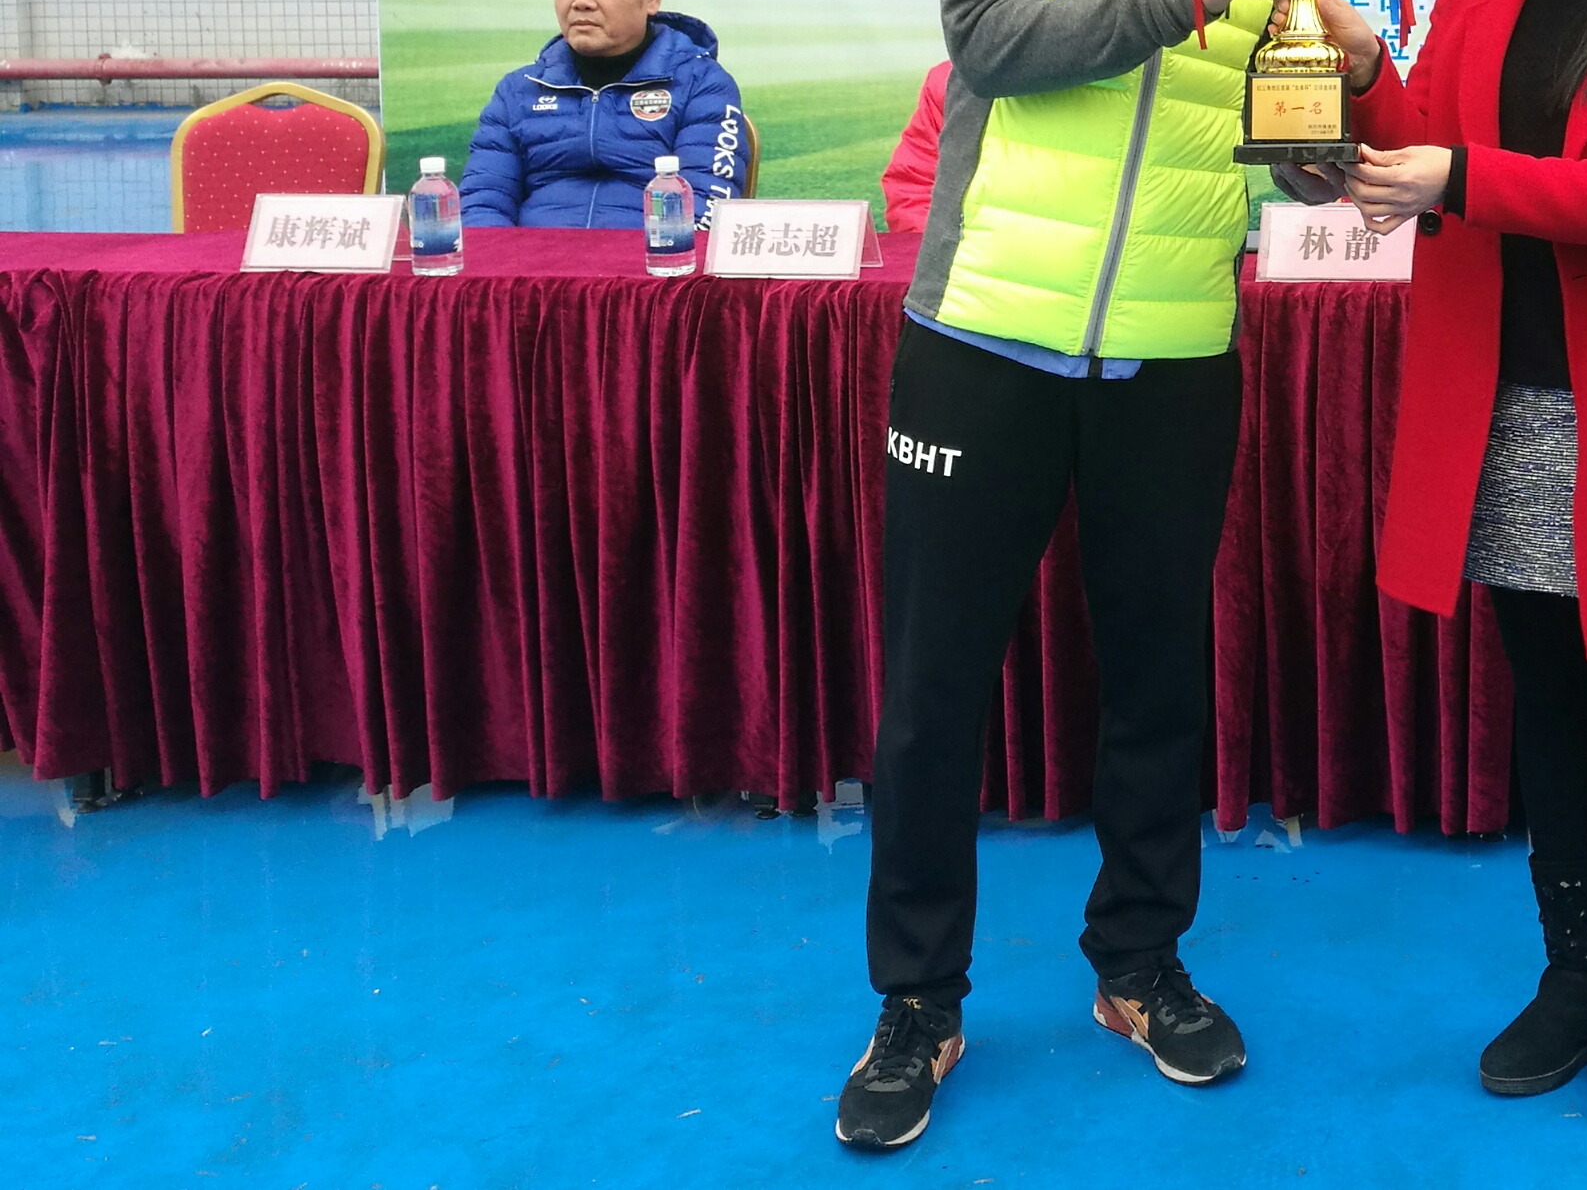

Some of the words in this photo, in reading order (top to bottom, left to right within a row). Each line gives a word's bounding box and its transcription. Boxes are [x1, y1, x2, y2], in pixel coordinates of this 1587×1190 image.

[1274, 101, 1322, 117] 第一名
[713, 104, 741, 179] LOOKS
[264, 214, 372, 251] 康辉斌
[731, 222, 840, 258] 潘志超
[1298, 226, 1380, 261] 林静
[887, 426, 962, 477] KBHT
